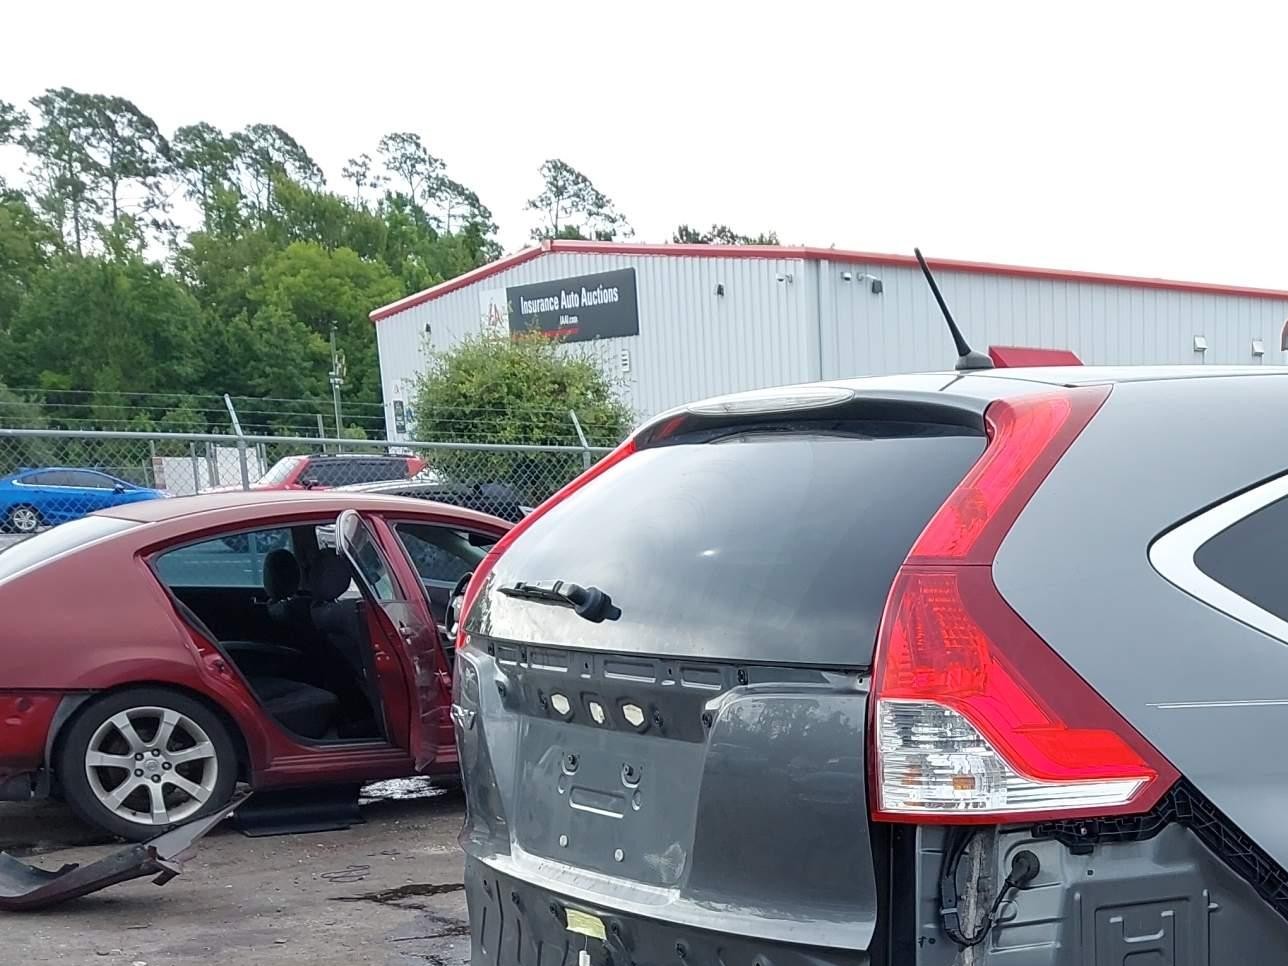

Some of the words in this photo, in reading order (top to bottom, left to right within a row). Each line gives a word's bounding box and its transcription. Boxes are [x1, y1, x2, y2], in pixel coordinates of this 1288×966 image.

[520, 295, 559, 315] Insurance
[560, 289, 579, 309] Auto
[581, 285, 619, 307] Auctions
